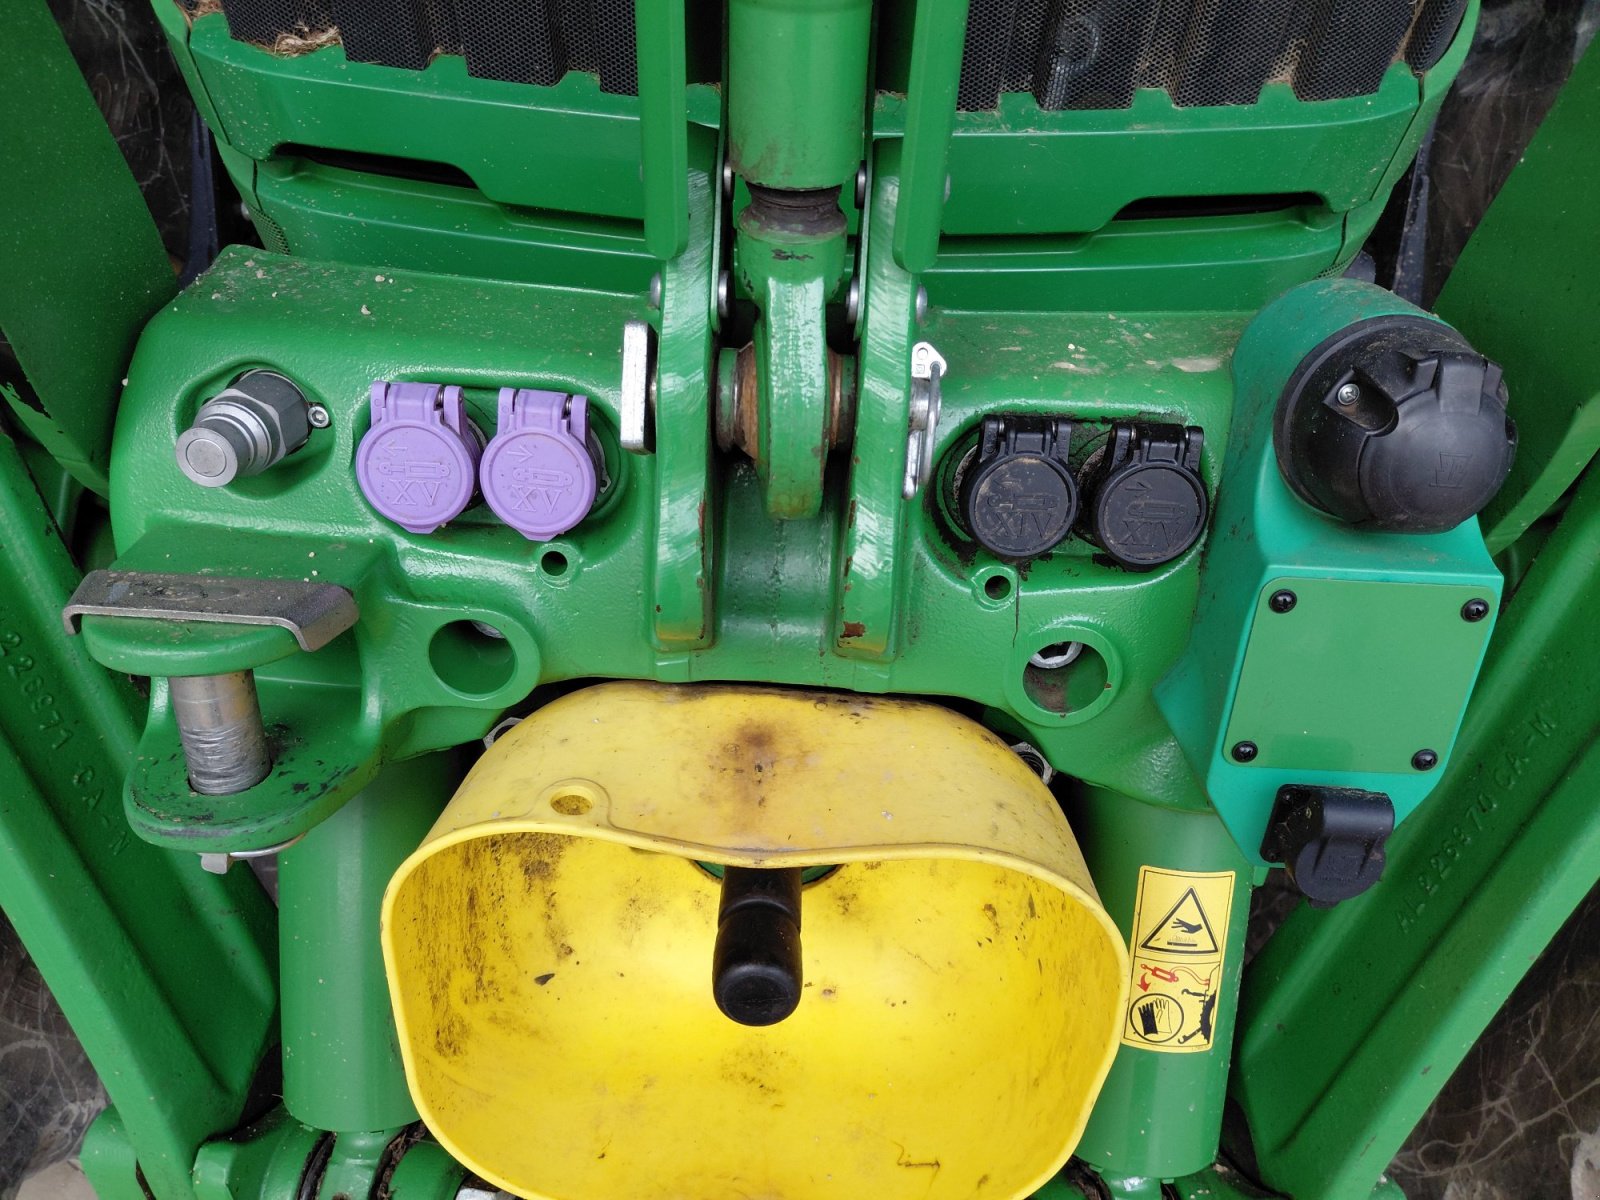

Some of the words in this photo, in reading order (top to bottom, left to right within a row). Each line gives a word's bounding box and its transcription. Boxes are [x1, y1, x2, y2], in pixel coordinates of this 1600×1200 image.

[389, 479, 441, 506] XV
[511, 484, 562, 513] XV
[987, 511, 1053, 539] XIV
[1118, 519, 1180, 548] XIV
